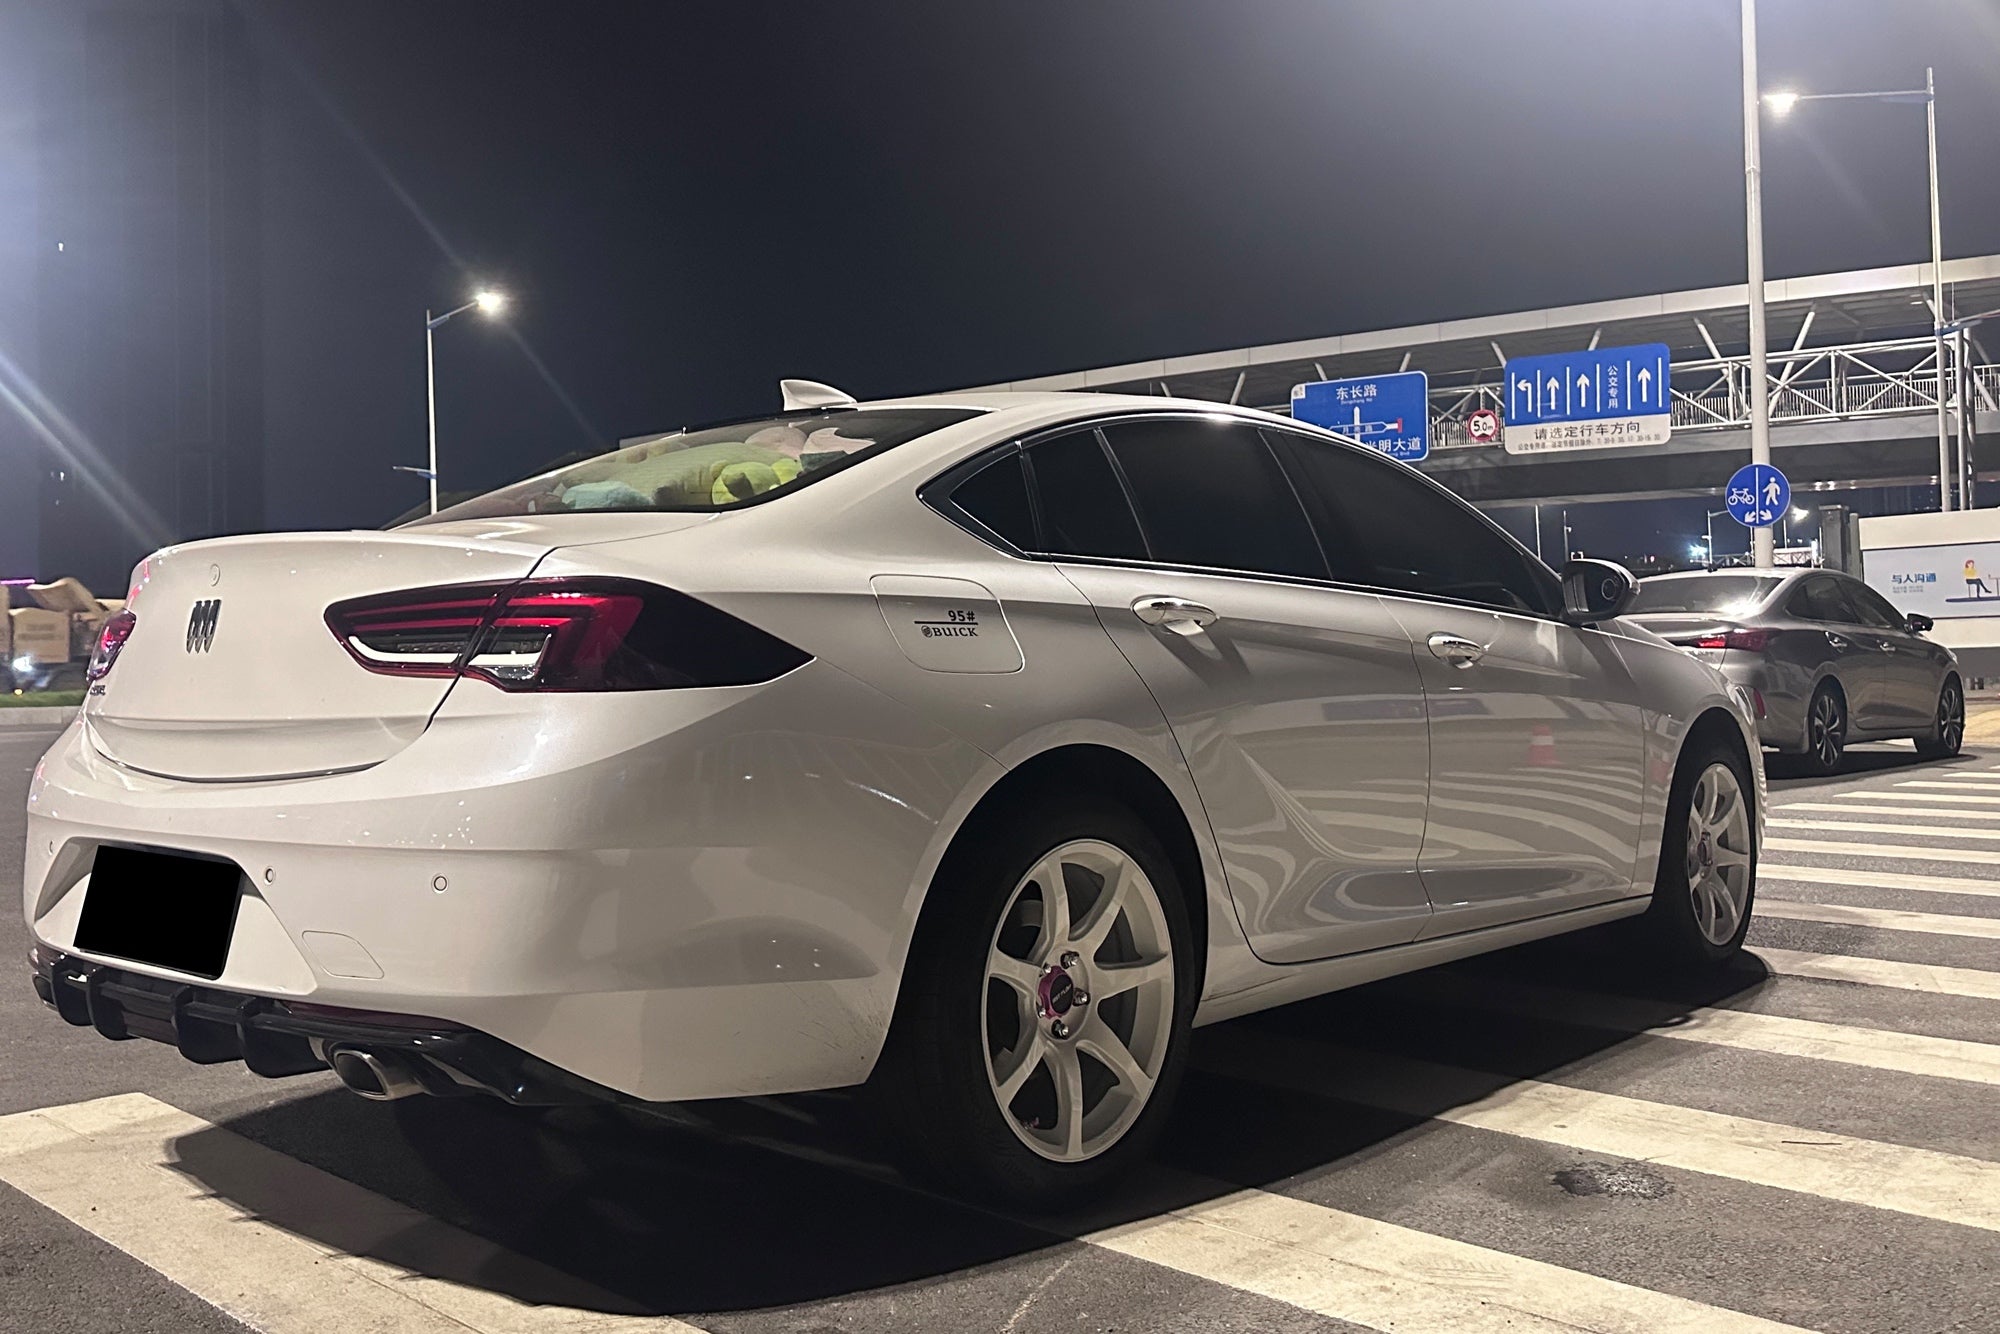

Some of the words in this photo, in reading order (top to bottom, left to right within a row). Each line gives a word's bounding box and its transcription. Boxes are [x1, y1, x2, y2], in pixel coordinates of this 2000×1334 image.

[1336, 384, 1377, 400] 东长路
[1607, 365, 1618, 409] 公交专用
[1534, 420, 1640, 440] 请选定行车方向
[1892, 573, 1936, 584] 与人沟通
[948, 610, 976, 621] 95#
[932, 627, 979, 637] BUICK
